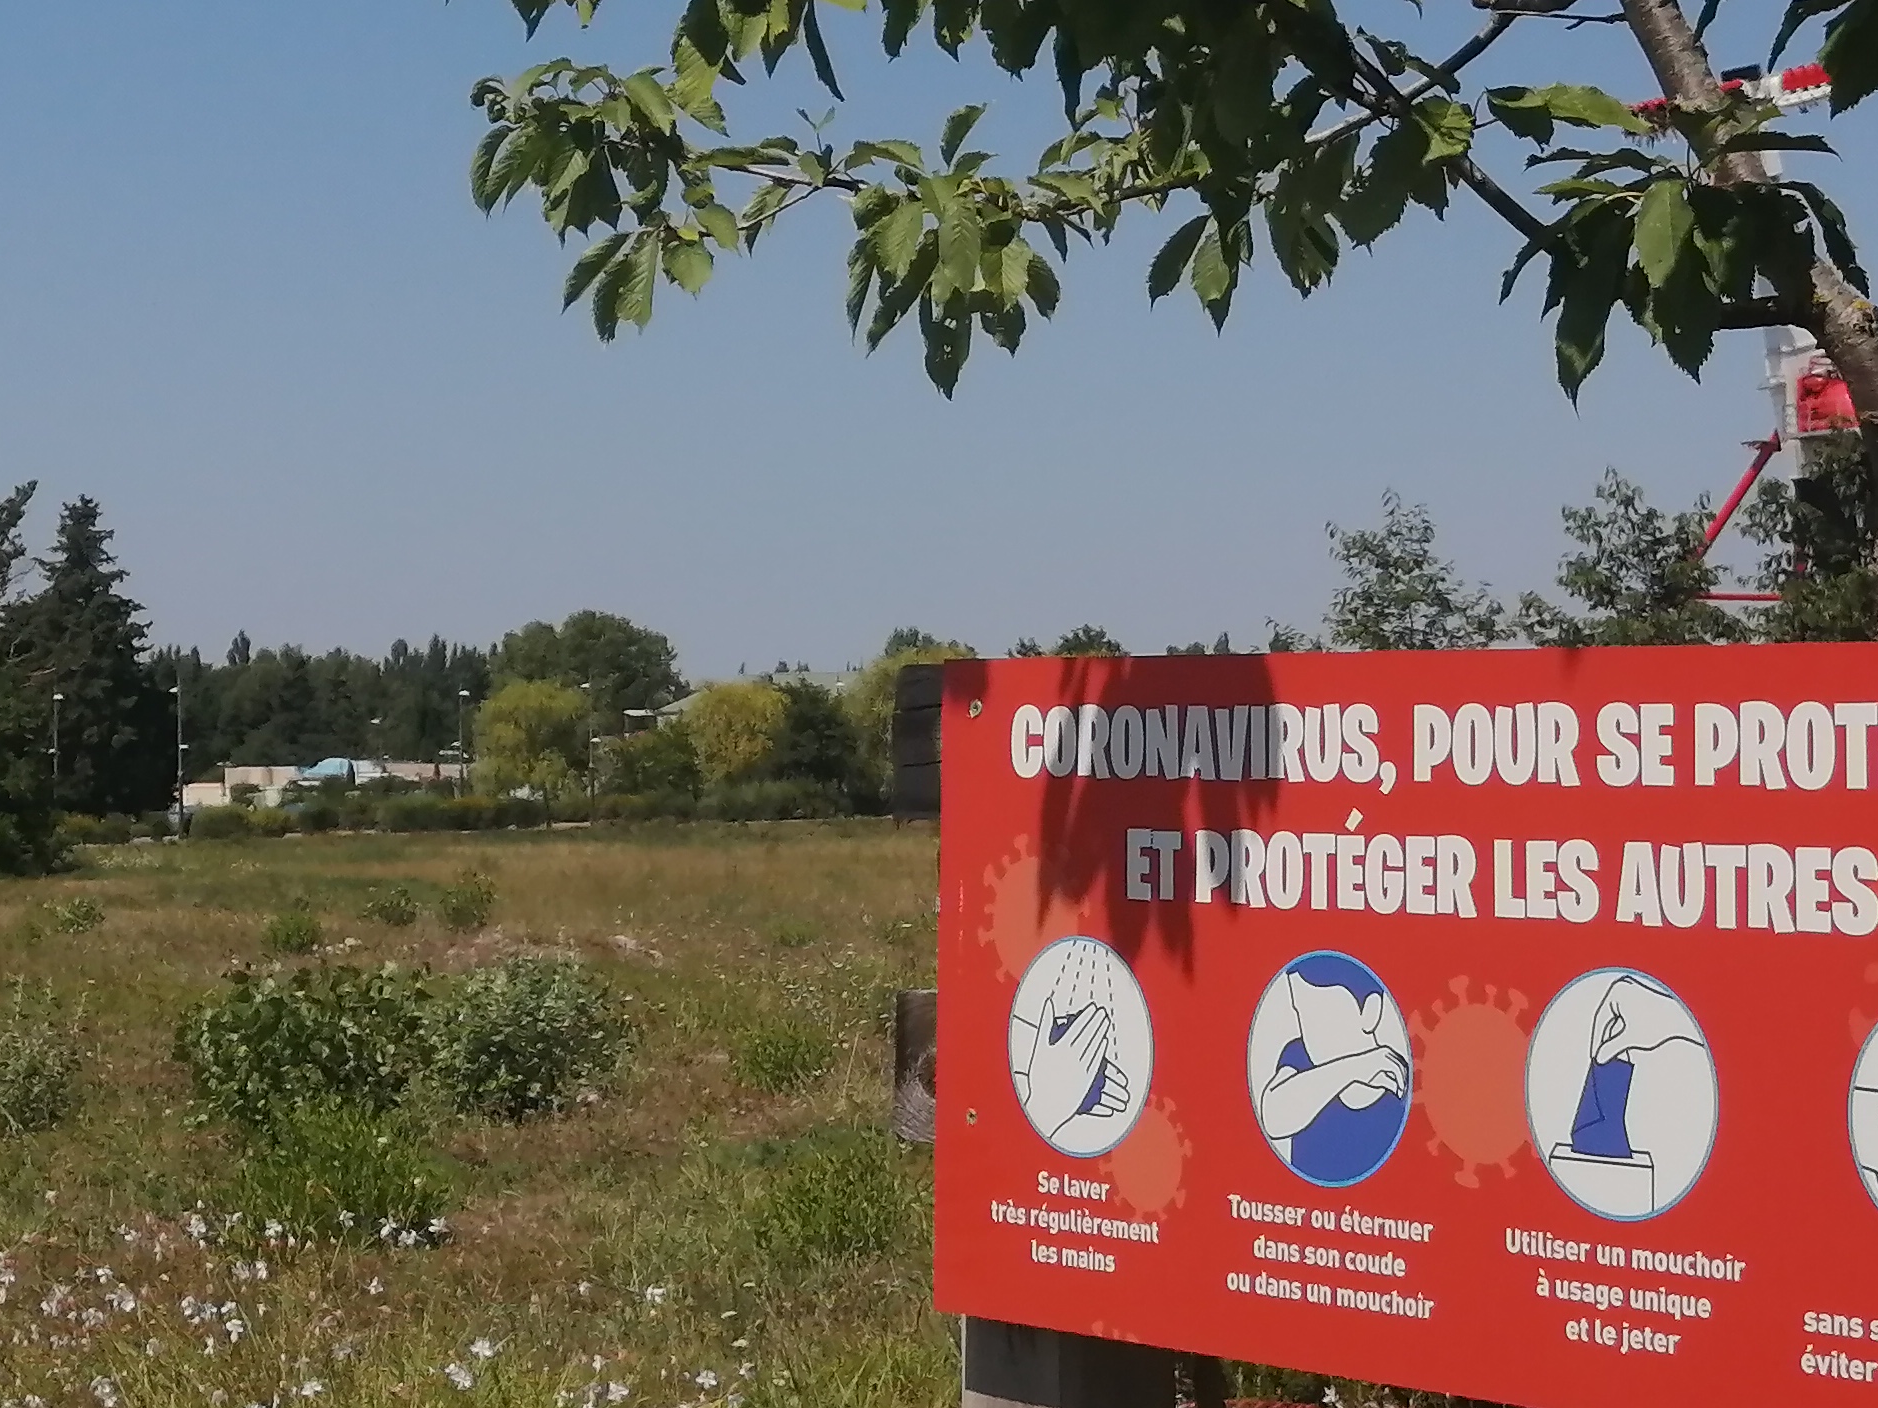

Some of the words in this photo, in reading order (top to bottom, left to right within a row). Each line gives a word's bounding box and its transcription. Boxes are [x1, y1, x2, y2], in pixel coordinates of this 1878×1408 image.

[1010, 702, 1398, 795] CORONAVIRUS,
[1412, 701, 1581, 788] POUR
[1595, 701, 1675, 788] SE
[1125, 827, 1182, 901] ET
[1194, 807, 1478, 919] PROTÉGER
[1493, 838, 1600, 923] LES
[1037, 1170, 1060, 1195] Se
[1063, 1173, 1111, 1203] laver
[990, 1198, 1026, 1225] très
[1029, 1201, 1159, 1244] régulièrement
[1227, 1193, 1306, 1227] Tousser
[1310, 1209, 1336, 1231] ou
[1340, 1205, 1434, 1243] éternuer
[1030, 1238, 1058, 1264] les
[1061, 1245, 1116, 1273] mains
[1253, 1234, 1301, 1263] dans
[1303, 1245, 1341, 1269] son
[1344, 1251, 1407, 1278] coude
[1504, 1226, 1591, 1263] Utiliser
[1596, 1243, 1626, 1267] un
[1631, 1248, 1746, 1282] mouchoir
[1226, 1271, 1251, 1293] ou
[1254, 1269, 1302, 1301] dans
[1306, 1283, 1332, 1306] un
[1335, 1286, 1435, 1320] mouchoir
[1535, 1267, 1550, 1298] à
[1555, 1278, 1624, 1311] usage
[1629, 1286, 1712, 1321] unique
[1565, 1317, 1589, 1342] et
[1594, 1318, 1618, 1346] le
[1619, 1320, 1681, 1355] jeter
[1803, 1310, 1864, 1339] sans
[1800, 1343, 1878, 1383] éviter
